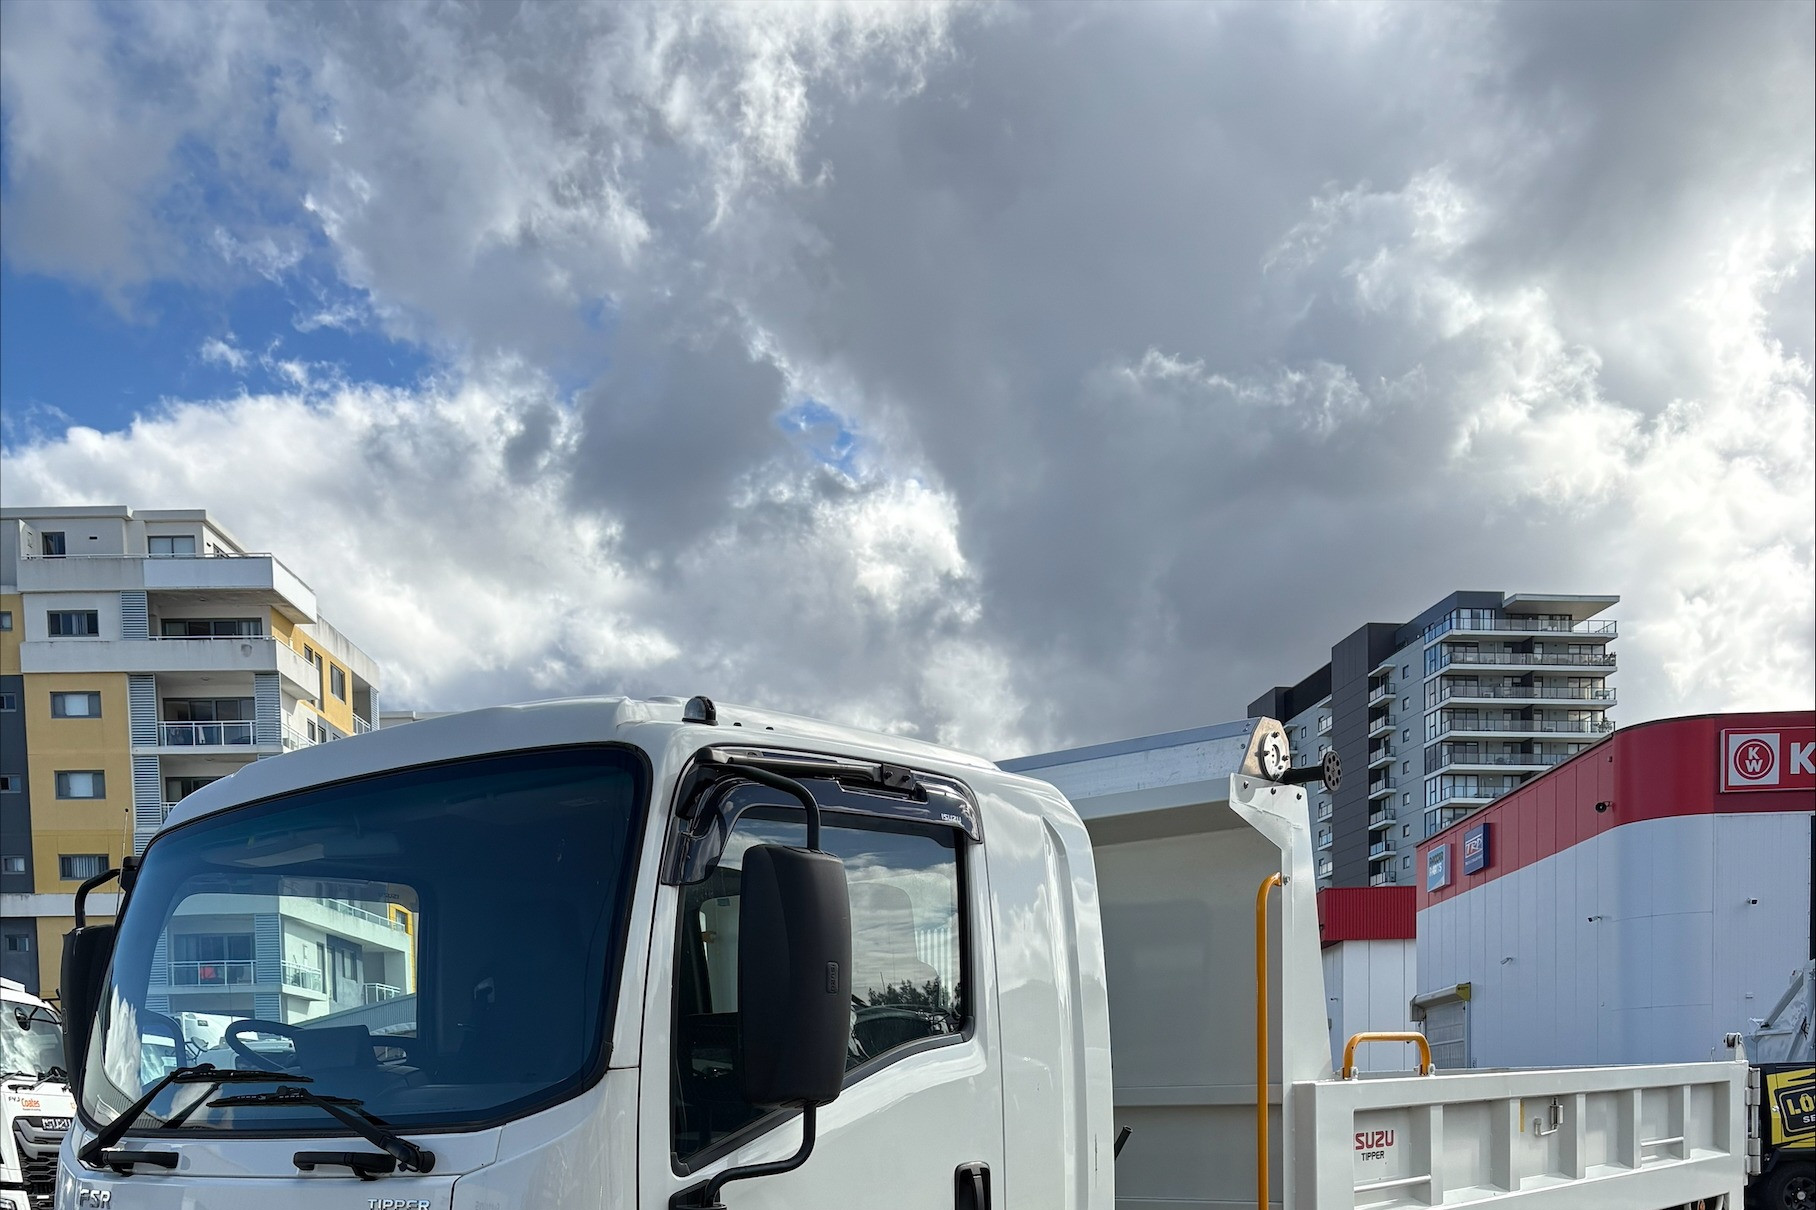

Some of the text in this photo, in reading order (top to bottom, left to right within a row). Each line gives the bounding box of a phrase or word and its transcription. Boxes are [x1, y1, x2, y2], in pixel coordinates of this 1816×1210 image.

[941, 813, 962, 822] ISUZU
[42, 1118, 71, 1130] ISUZU
[1355, 1130, 1394, 1150] SUZU
[1361, 1151, 1385, 1161] TIPPER
[80, 1188, 111, 1209] FSR
